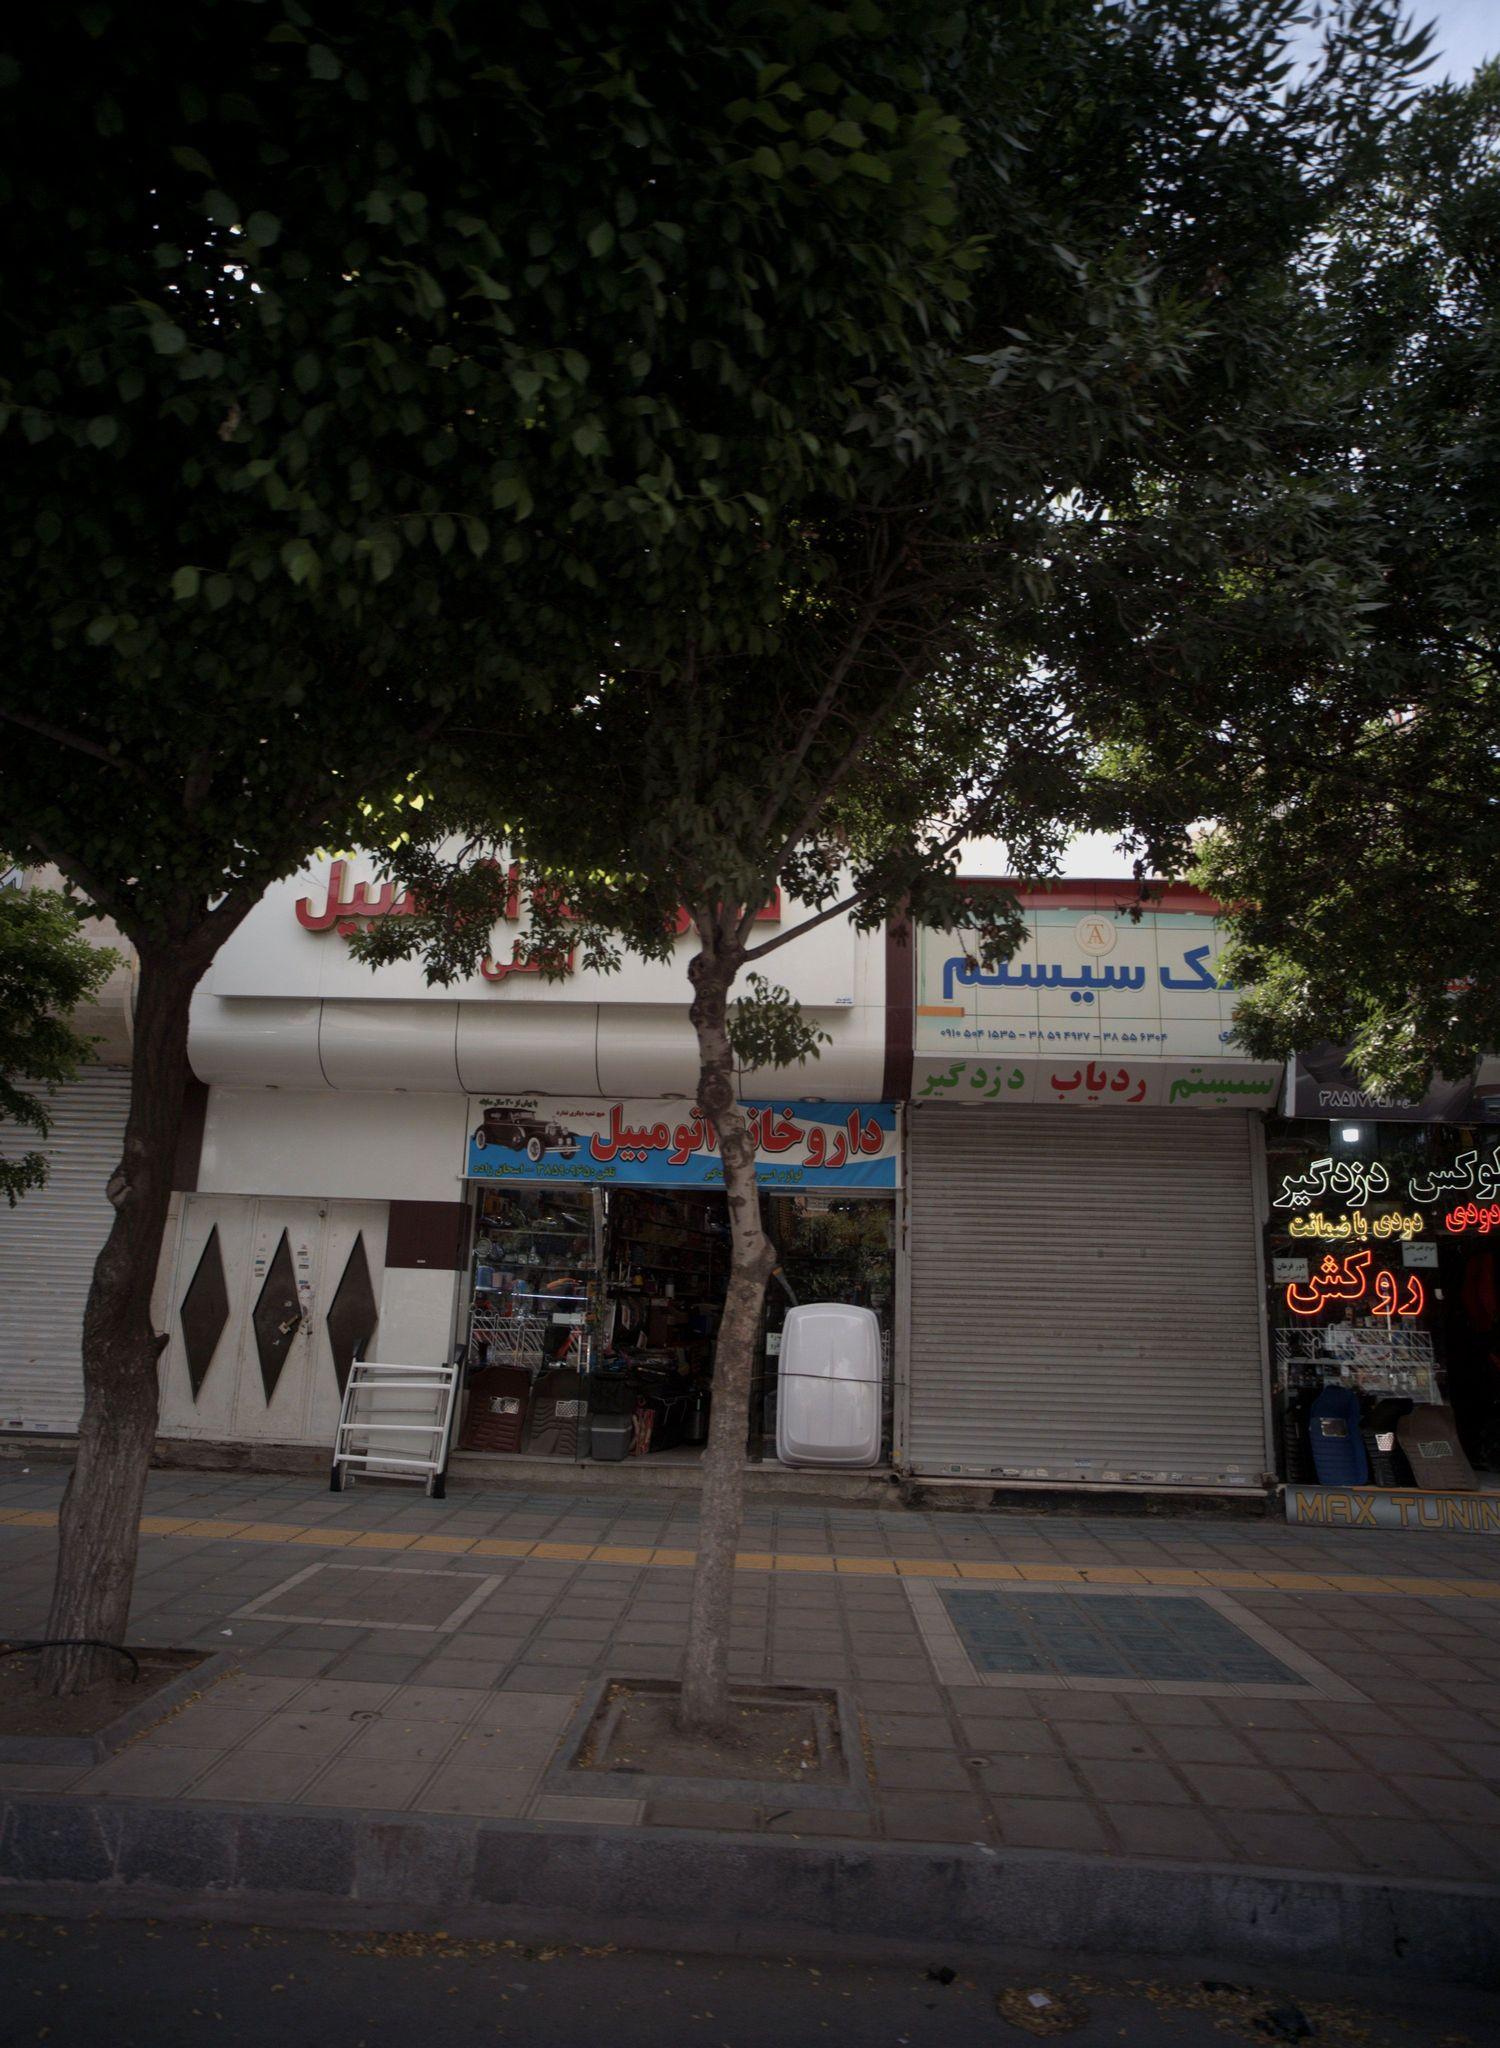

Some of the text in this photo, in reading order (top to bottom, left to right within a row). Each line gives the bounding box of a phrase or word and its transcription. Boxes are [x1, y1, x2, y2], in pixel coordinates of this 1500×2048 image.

[943, 953, 1145, 1003] سیستم
[1050, 1060, 1147, 1102] ردیاب
[1168, 1066, 1275, 1104] سیستم
[589, 1103, 886, 1168] داروخان اتومبیل
[1272, 1146, 1500, 1207] وکس دزدگیر
[1288, 1210, 1424, 1242] دودی با ضمانت
[1295, 1492, 1377, 1526] MAX
